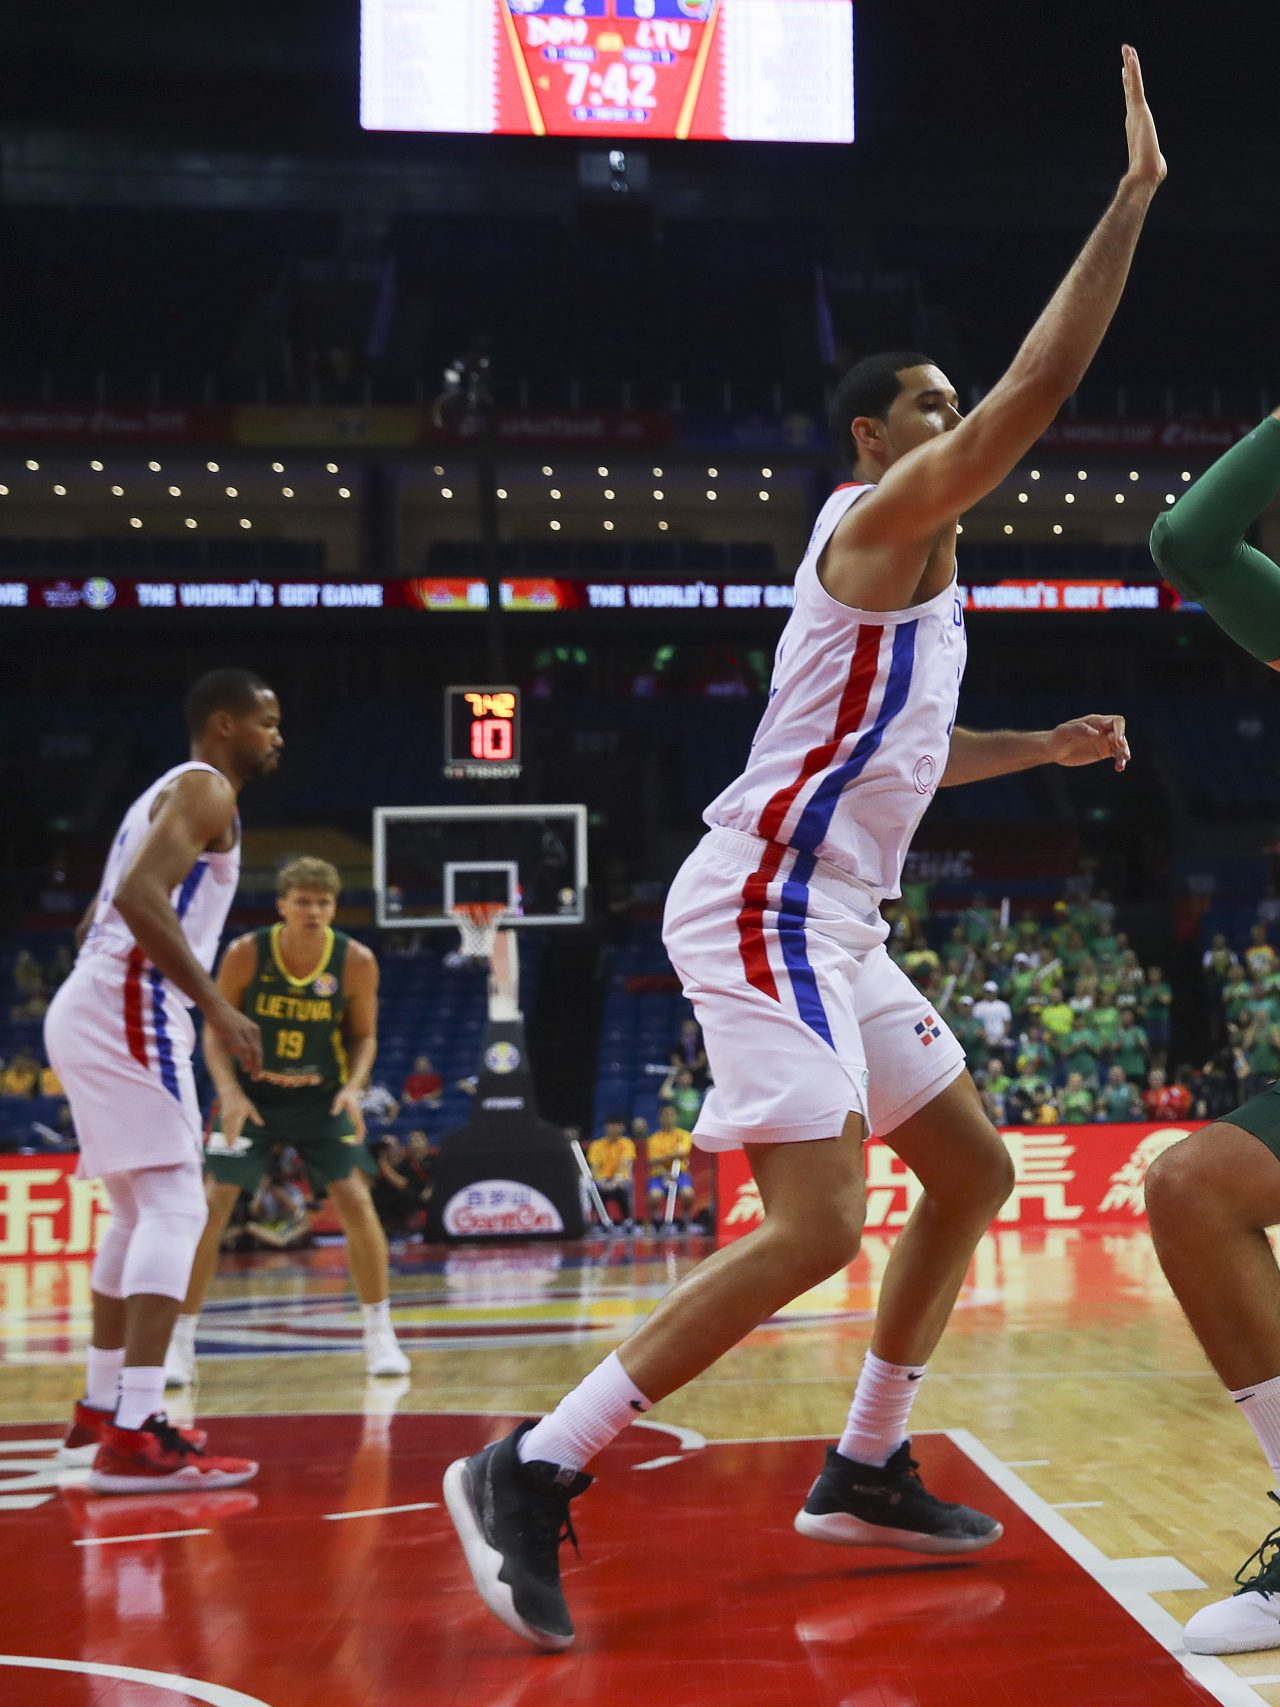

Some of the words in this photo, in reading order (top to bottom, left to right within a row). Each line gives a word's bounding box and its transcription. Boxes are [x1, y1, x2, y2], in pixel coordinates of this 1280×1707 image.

[635, 20, 691, 51] LTU
[563, 62, 656, 107] 7:42
[136, 583, 176, 607] THE
[587, 584, 625, 607] THE
[471, 720, 513, 759] 10
[256, 991, 334, 1022] LIETUVA
[276, 1028, 305, 1059] 19
